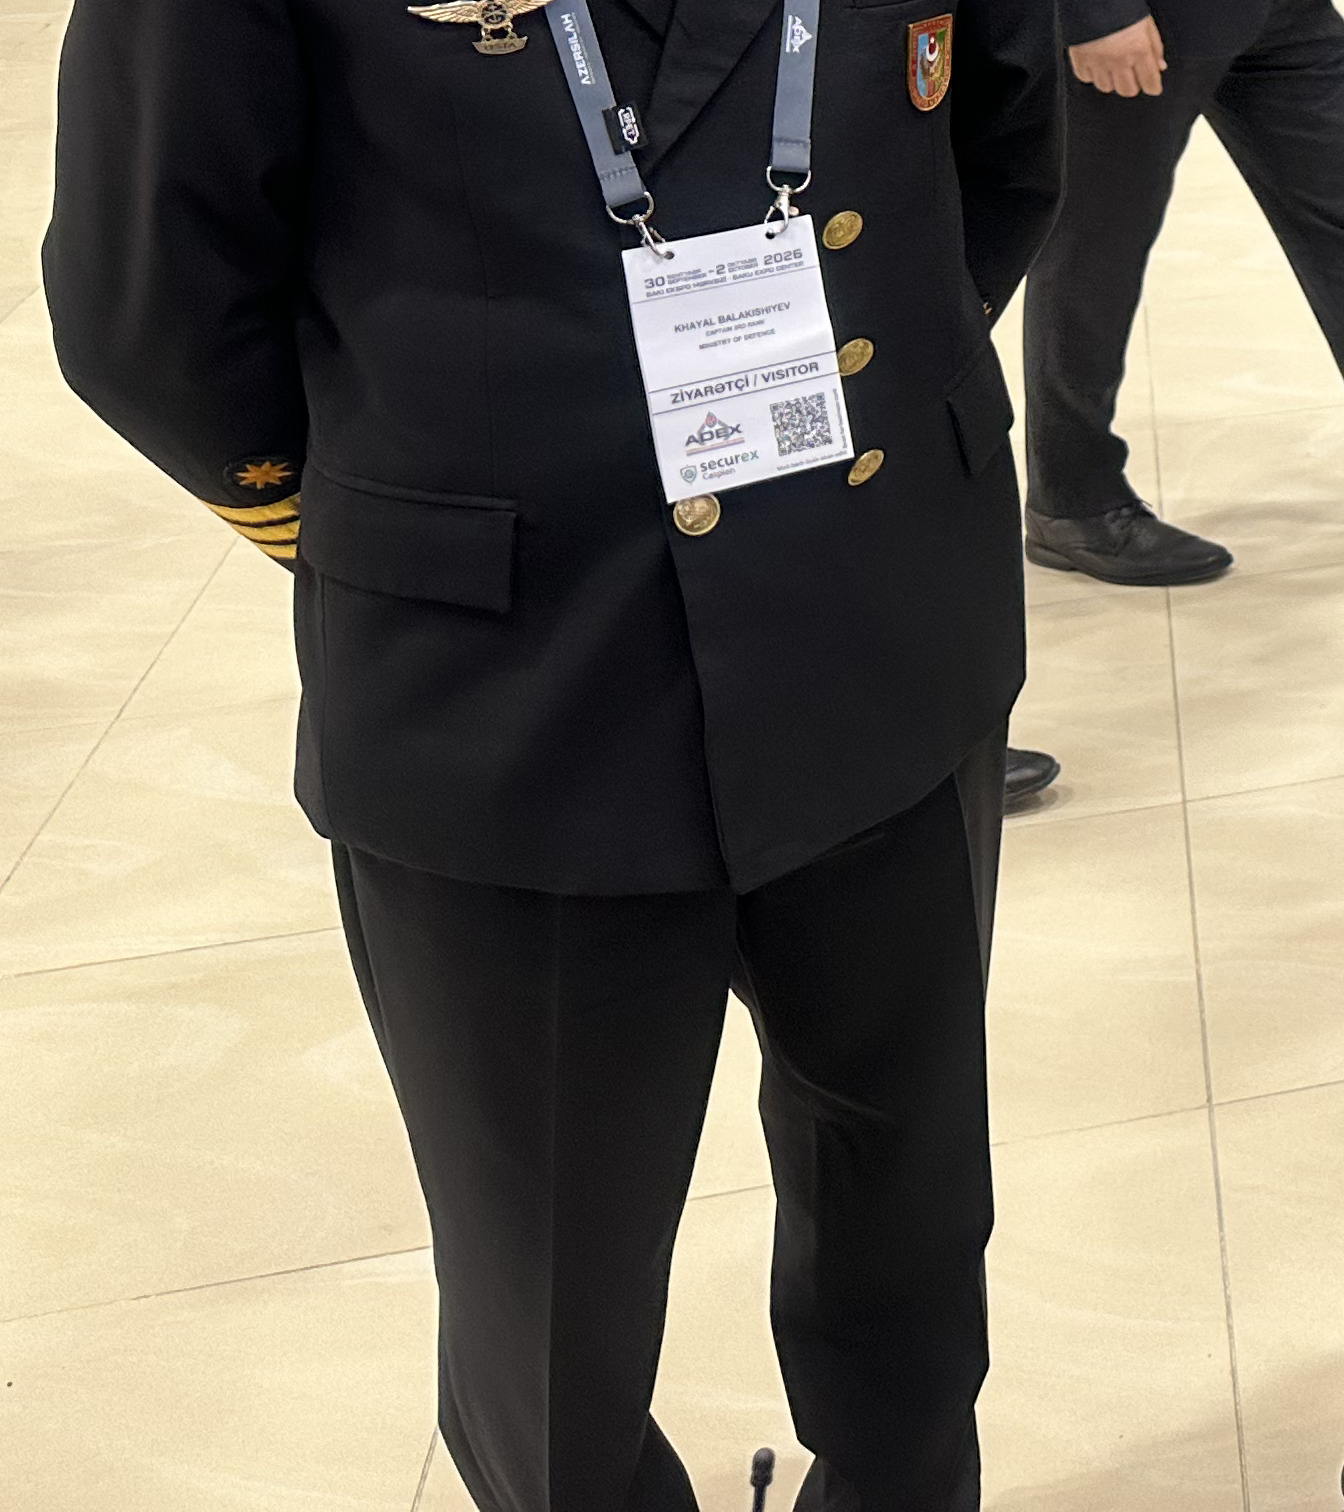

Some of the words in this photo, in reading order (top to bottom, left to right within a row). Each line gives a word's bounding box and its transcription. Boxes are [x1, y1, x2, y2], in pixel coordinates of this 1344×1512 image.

[561, 13, 592, 86] AZERSILAH
[763, 248, 803, 266] 2026
[644, 276, 666, 289] 30
[754, 266, 776, 277] EXPO
[674, 317, 716, 333] KHAYAL
[717, 301, 791, 324] BALAKISHIYEV
[732, 334, 743, 343] OF
[670, 376, 749, 405] ZİYARƏTÇİ
[761, 361, 819, 384] VISITOR
[685, 423, 742, 447] ADEX
[700, 450, 759, 473] securex
